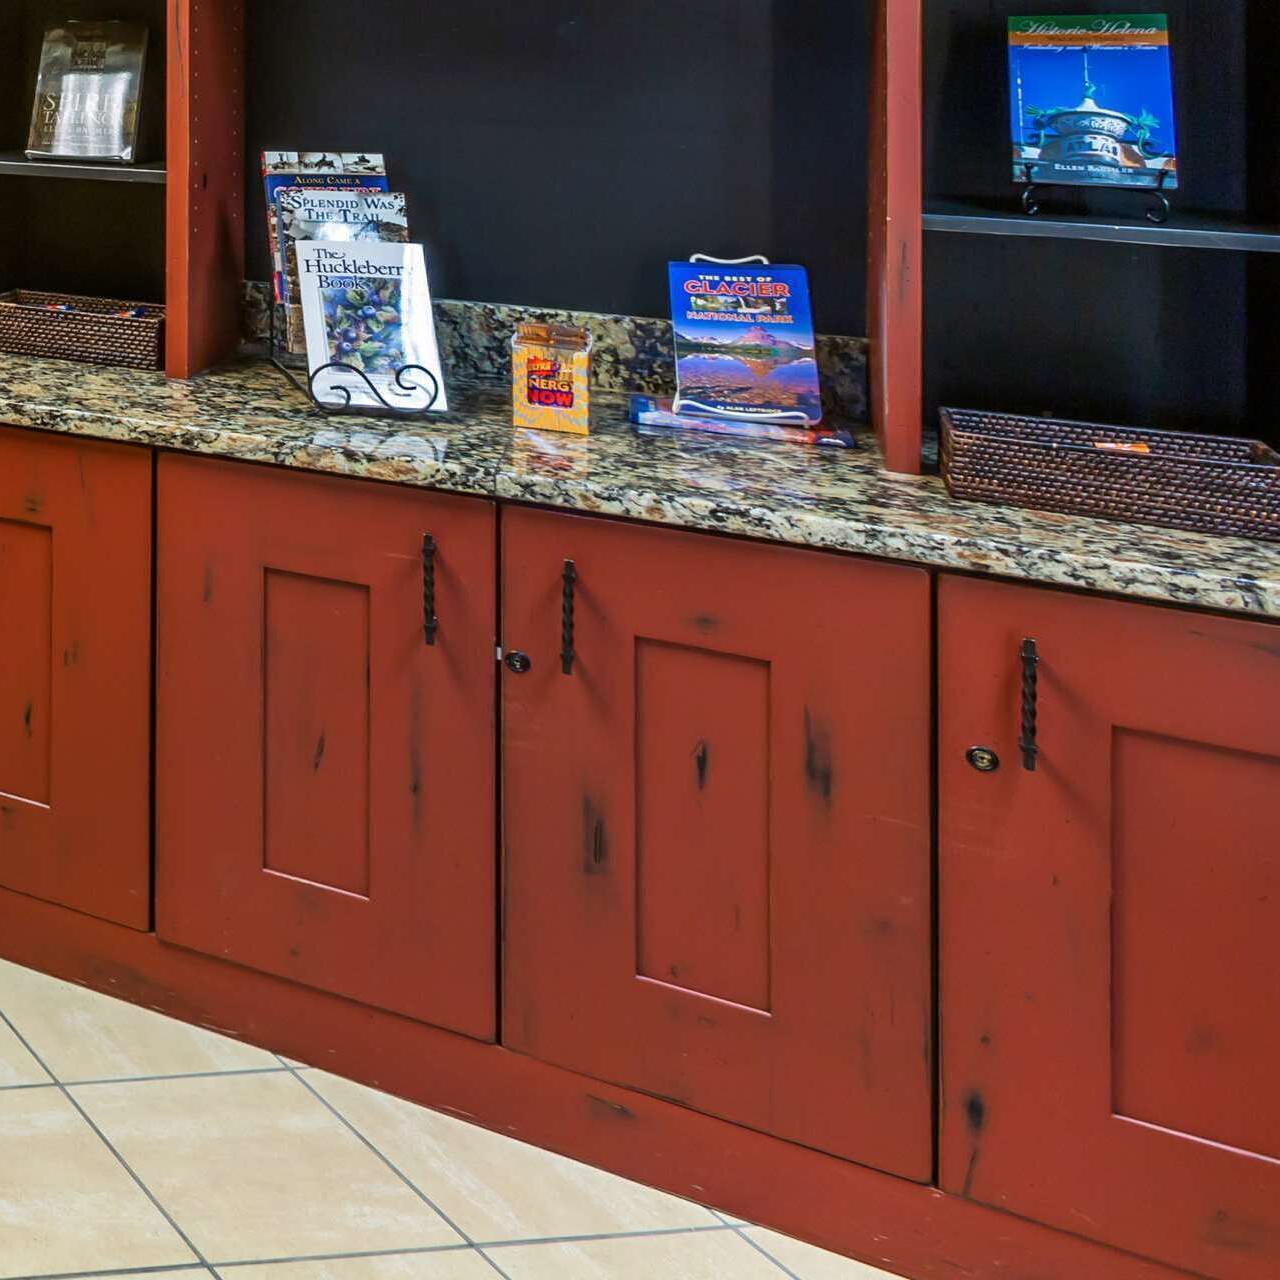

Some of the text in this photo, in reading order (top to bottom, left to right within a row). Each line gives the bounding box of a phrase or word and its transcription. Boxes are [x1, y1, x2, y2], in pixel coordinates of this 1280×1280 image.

[1016, 19, 1158, 35] Historic Helena
[1054, 163, 1085, 171] ELLEN
[294, 176, 325, 184] ALONG
[327, 176, 353, 185] CAME
[290, 195, 359, 209] SPLENDID
[313, 248, 346, 260] The
[305, 259, 404, 275] Huckleberr
[318, 274, 366, 290] Book
[698, 274, 773, 283] THE BEST OF
[683, 280, 791, 297] GLACIER
[686, 310, 794, 324] NATIONAL PARK
